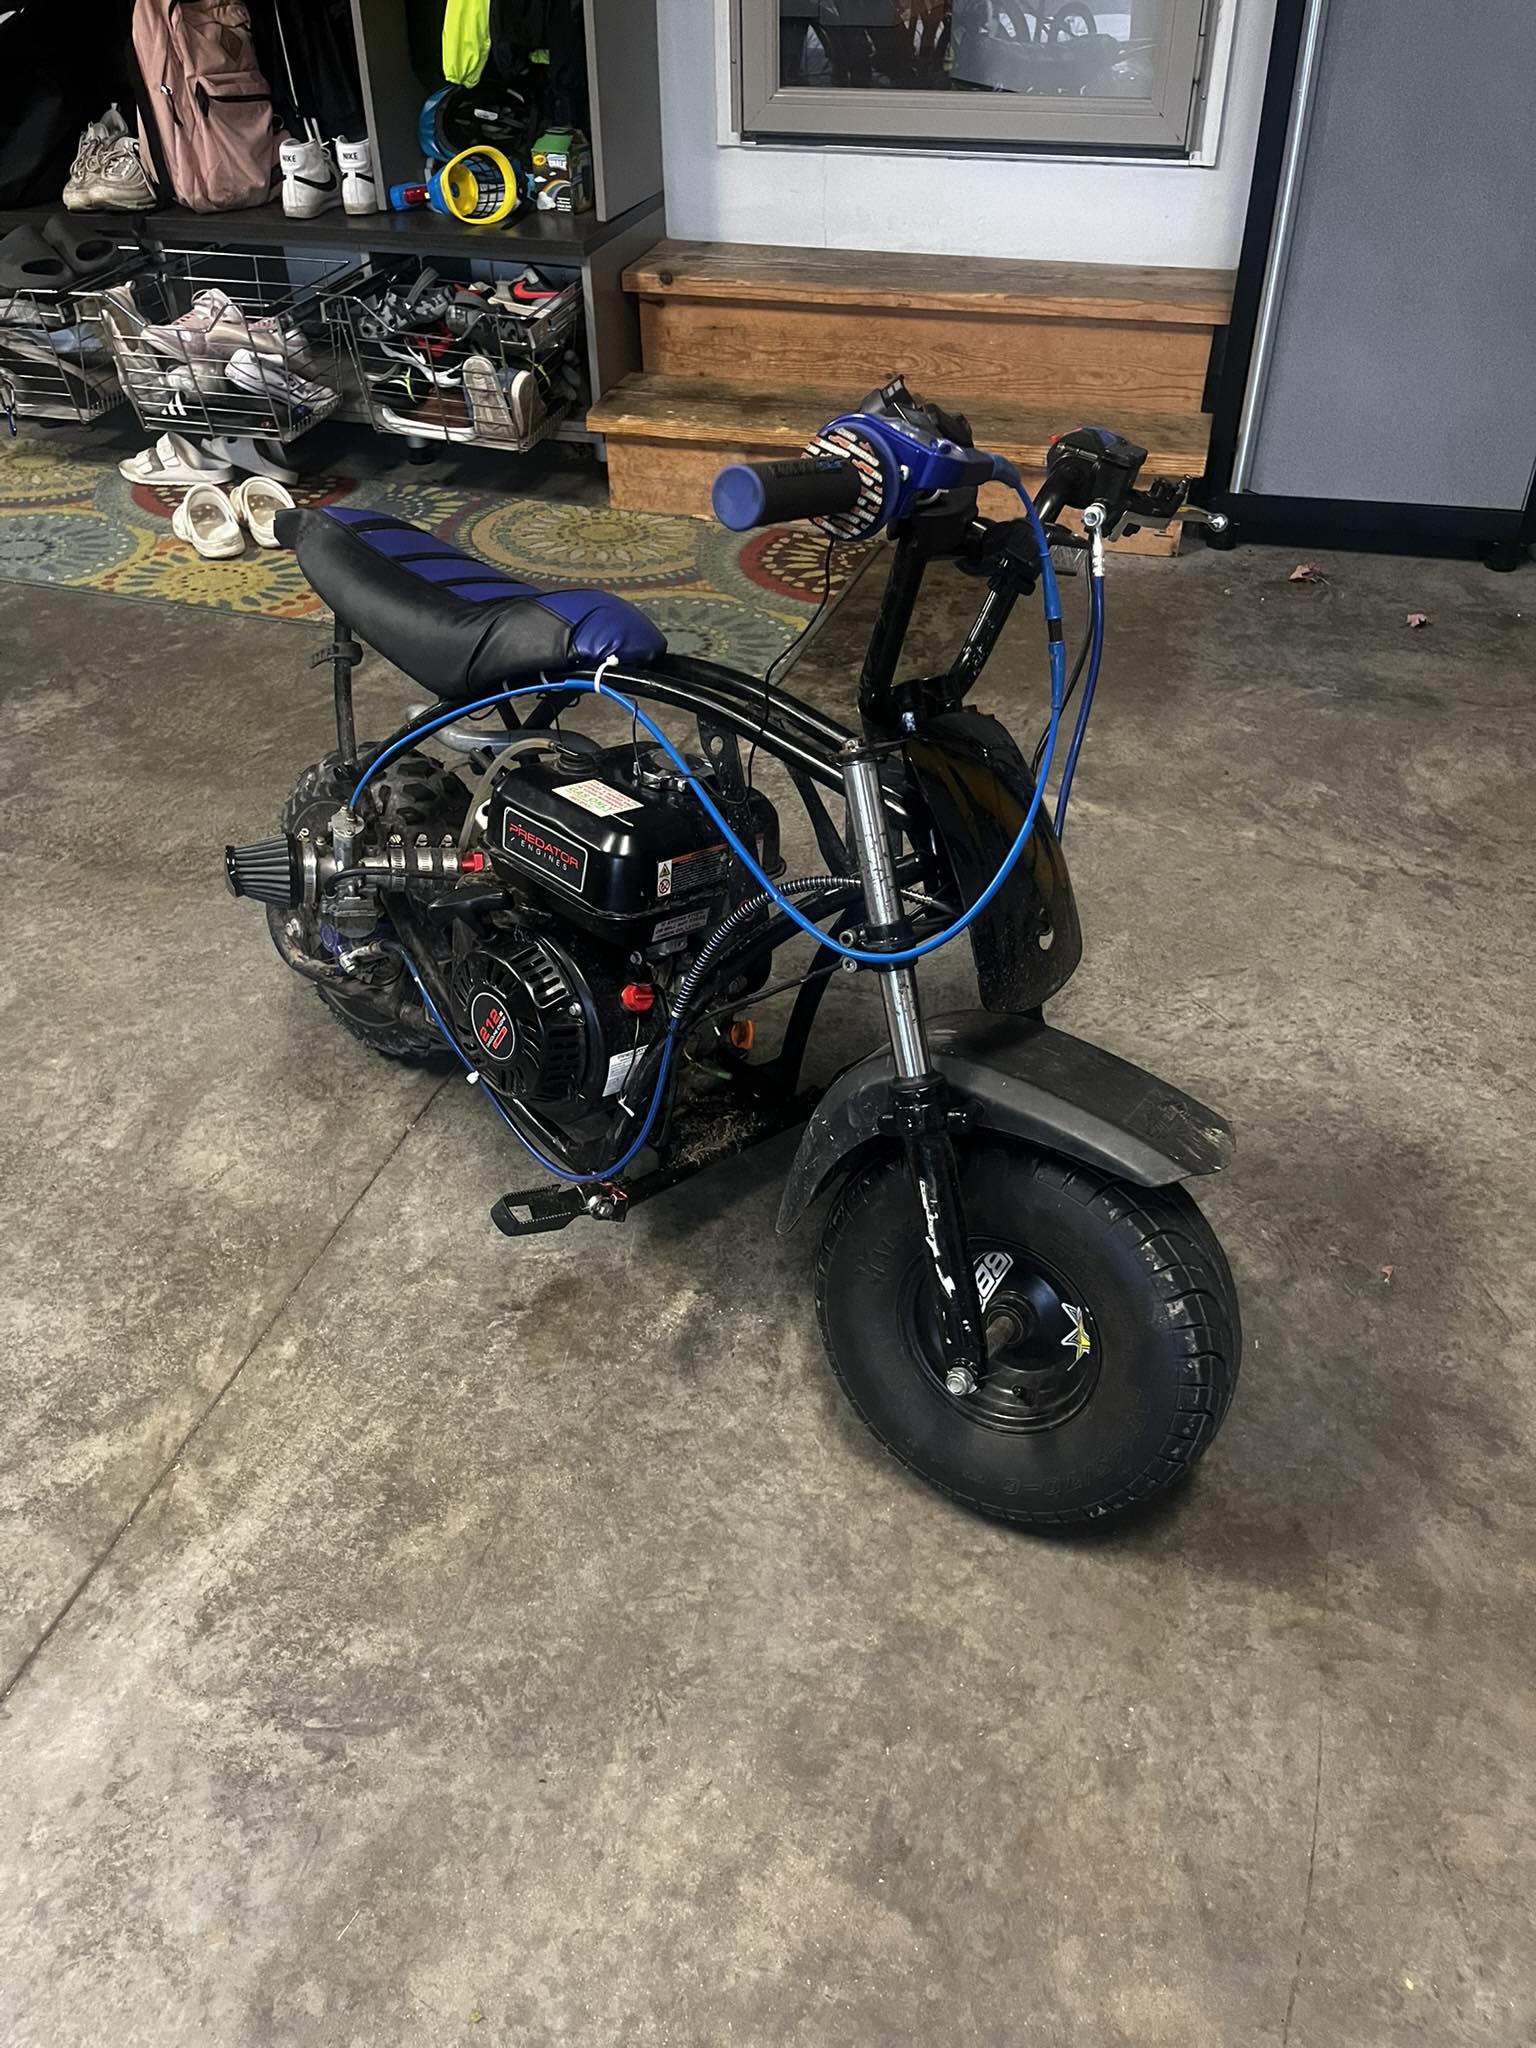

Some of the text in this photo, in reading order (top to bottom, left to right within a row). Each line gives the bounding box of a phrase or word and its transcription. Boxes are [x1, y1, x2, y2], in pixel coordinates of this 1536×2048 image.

[282, 154, 296, 163] NIKE
[343, 152, 359, 161] NIKE
[509, 823, 579, 869] PREDATOR
[520, 839, 568, 871] ENGINES
[480, 1008, 501, 1043] 212
